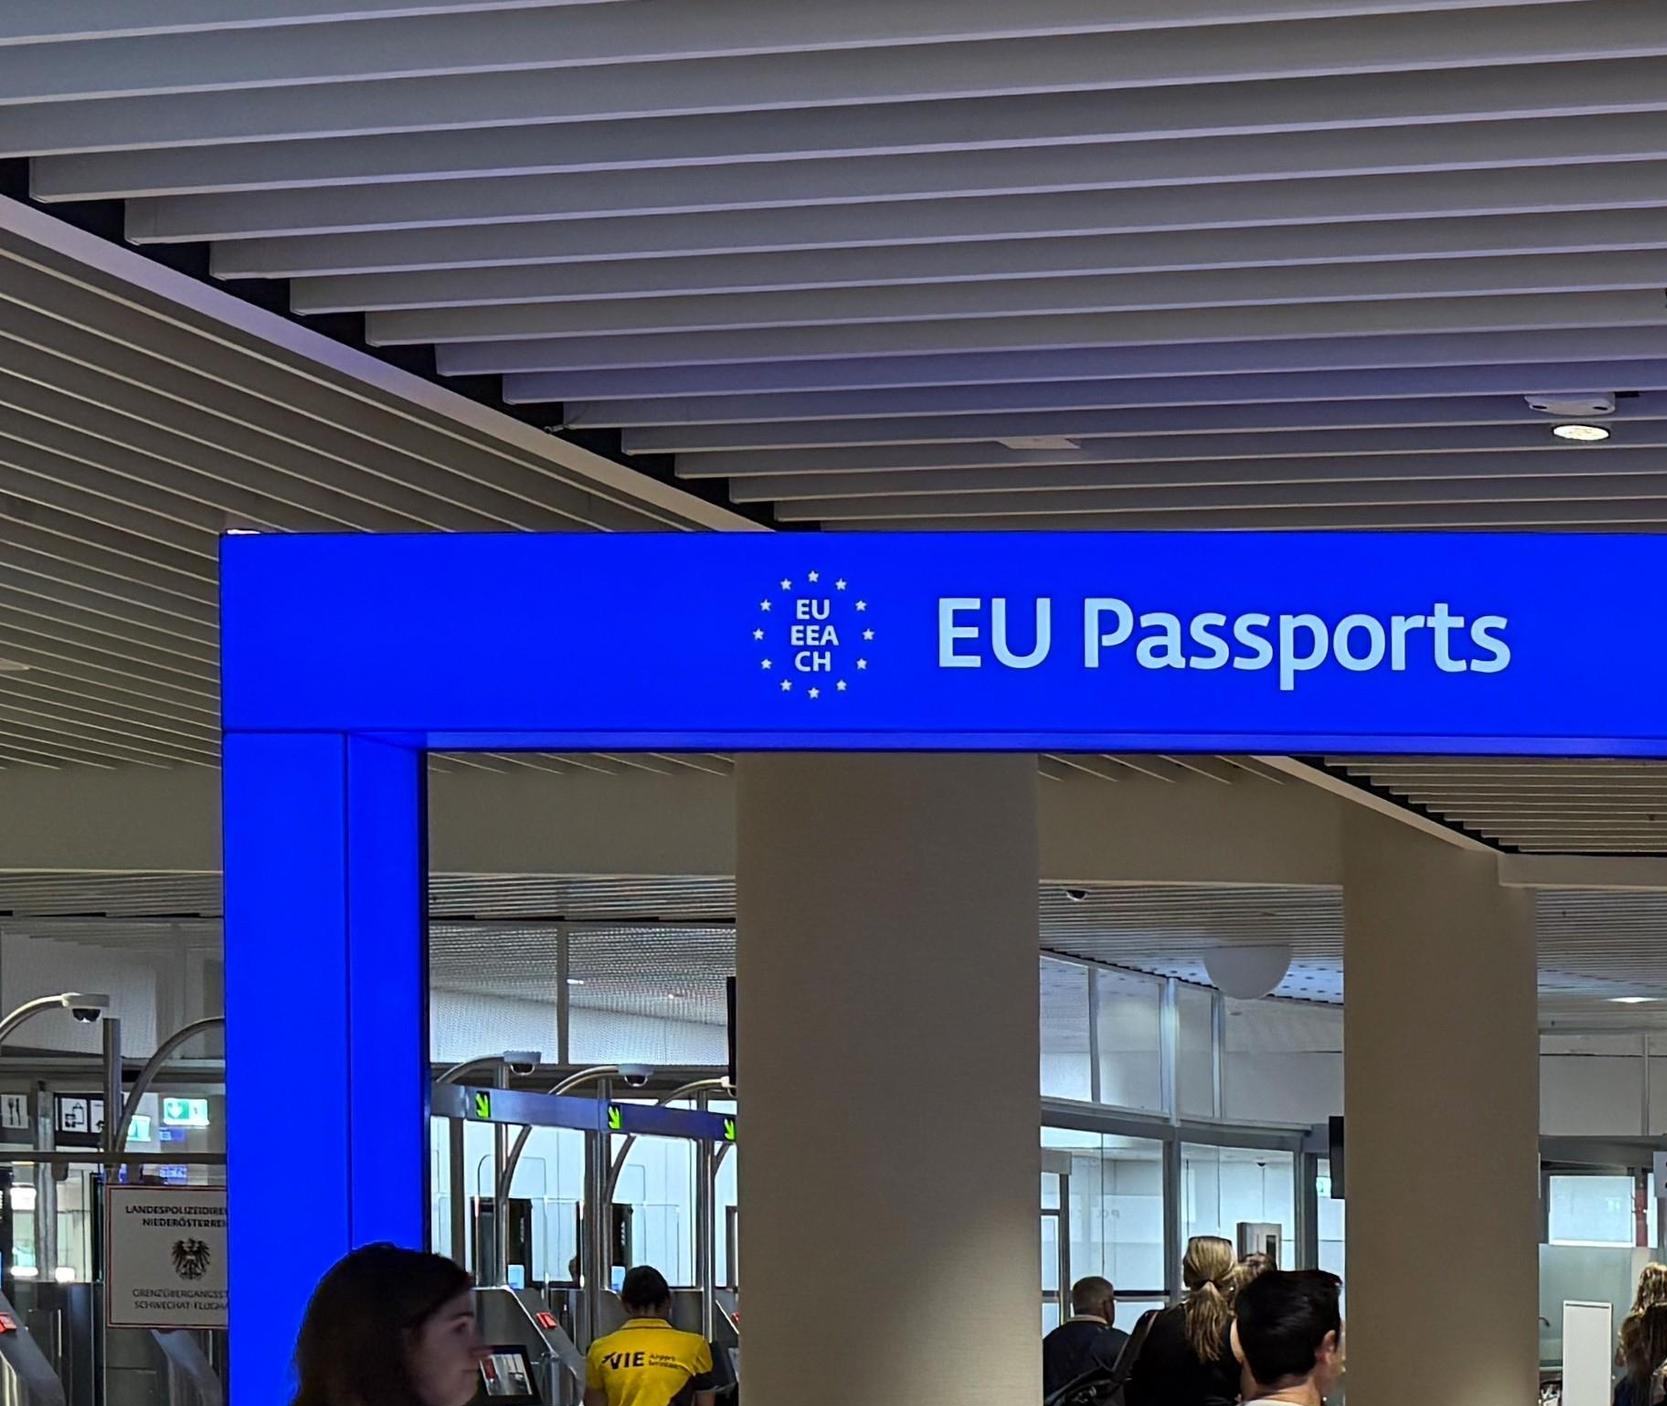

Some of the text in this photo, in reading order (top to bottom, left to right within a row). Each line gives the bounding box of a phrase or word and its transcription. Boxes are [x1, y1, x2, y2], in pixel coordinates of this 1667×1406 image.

[796, 599, 831, 620] EU
[790, 625, 840, 646] EEA
[938, 597, 1512, 691] EU Passports
[794, 651, 831, 672] CH
[602, 1352, 645, 1370] VIE
